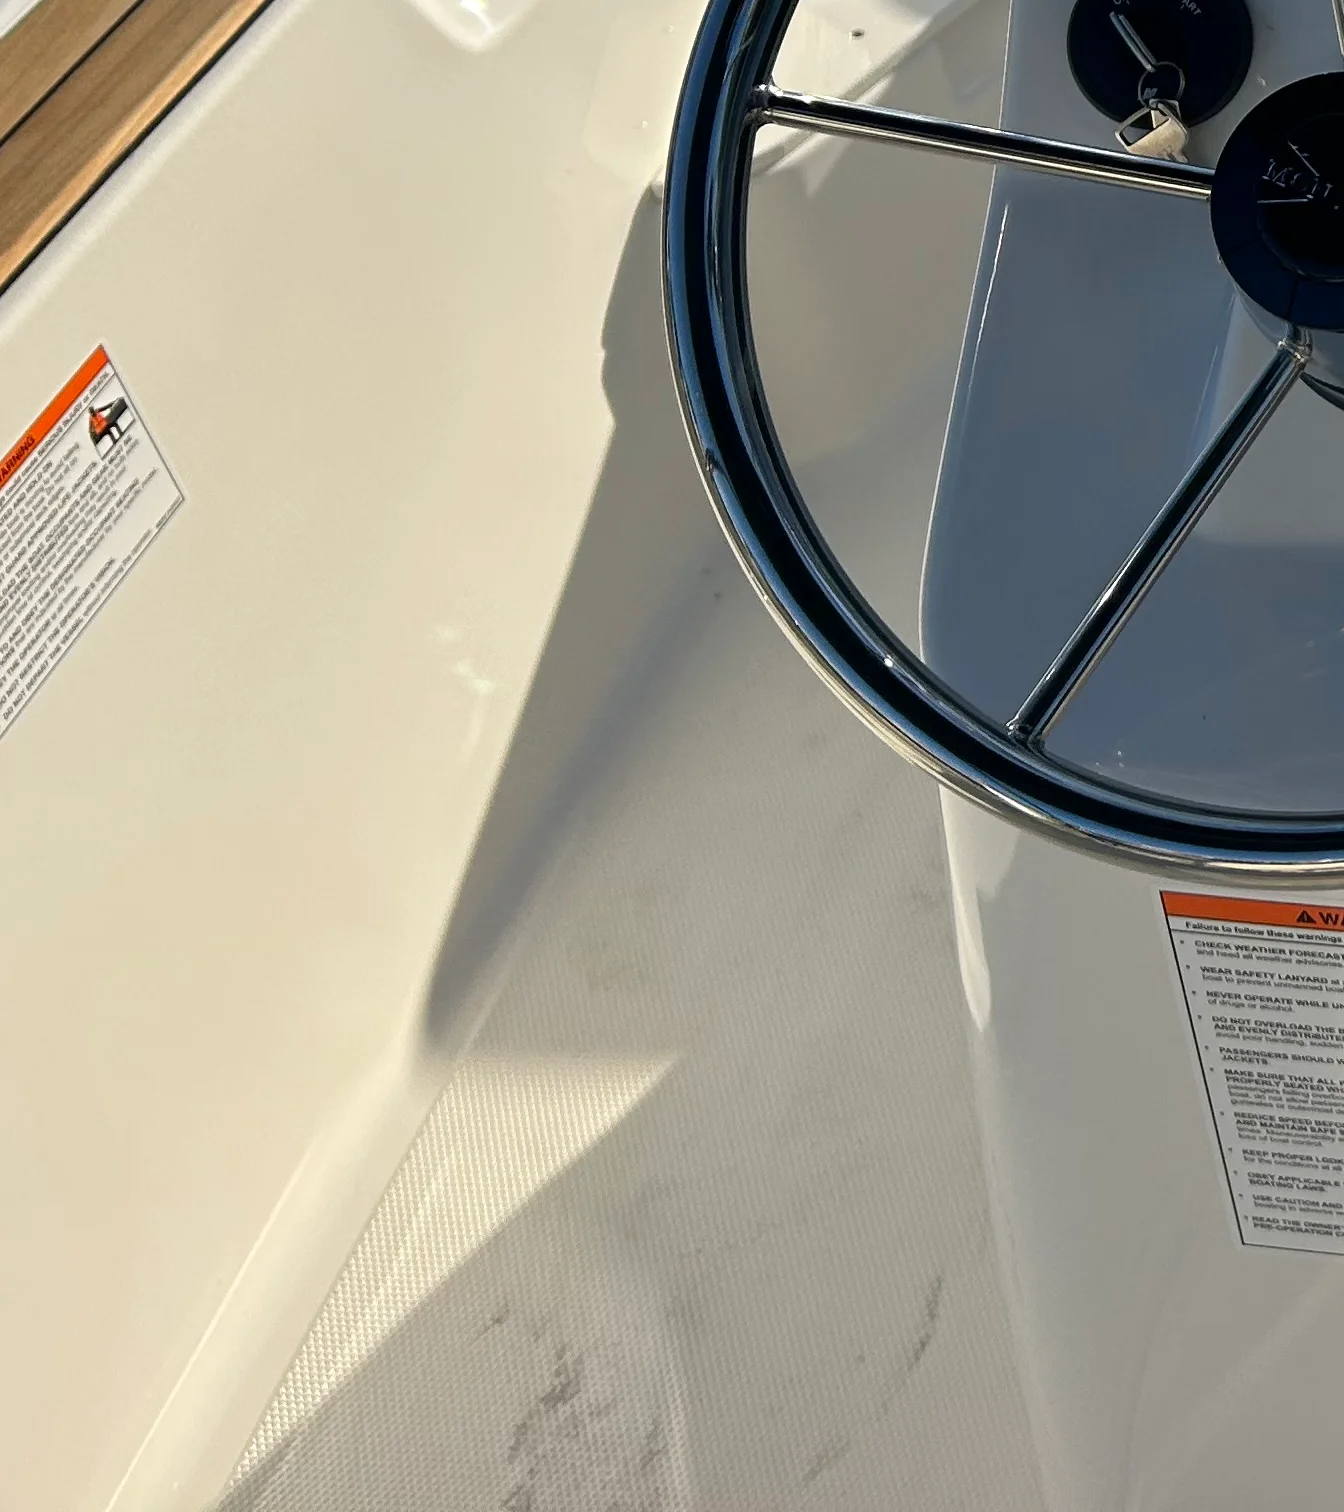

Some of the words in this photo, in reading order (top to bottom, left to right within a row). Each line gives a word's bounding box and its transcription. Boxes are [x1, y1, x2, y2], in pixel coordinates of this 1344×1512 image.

[0, 435, 36, 486] ARNING
[1186, 921, 1220, 931] Failure
[1221, 924, 1232, 932] to
[1234, 925, 1264, 935] follow
[1266, 927, 1294, 937] these
[1297, 930, 1342, 943] warnings
[1194, 940, 1230, 950] CHECK
[1234, 944, 1286, 954] WEATHER
[1200, 966, 1232, 975] WEAR
[1234, 969, 1275, 979] SAFETY
[1278, 973, 1328, 984] LANYARD
